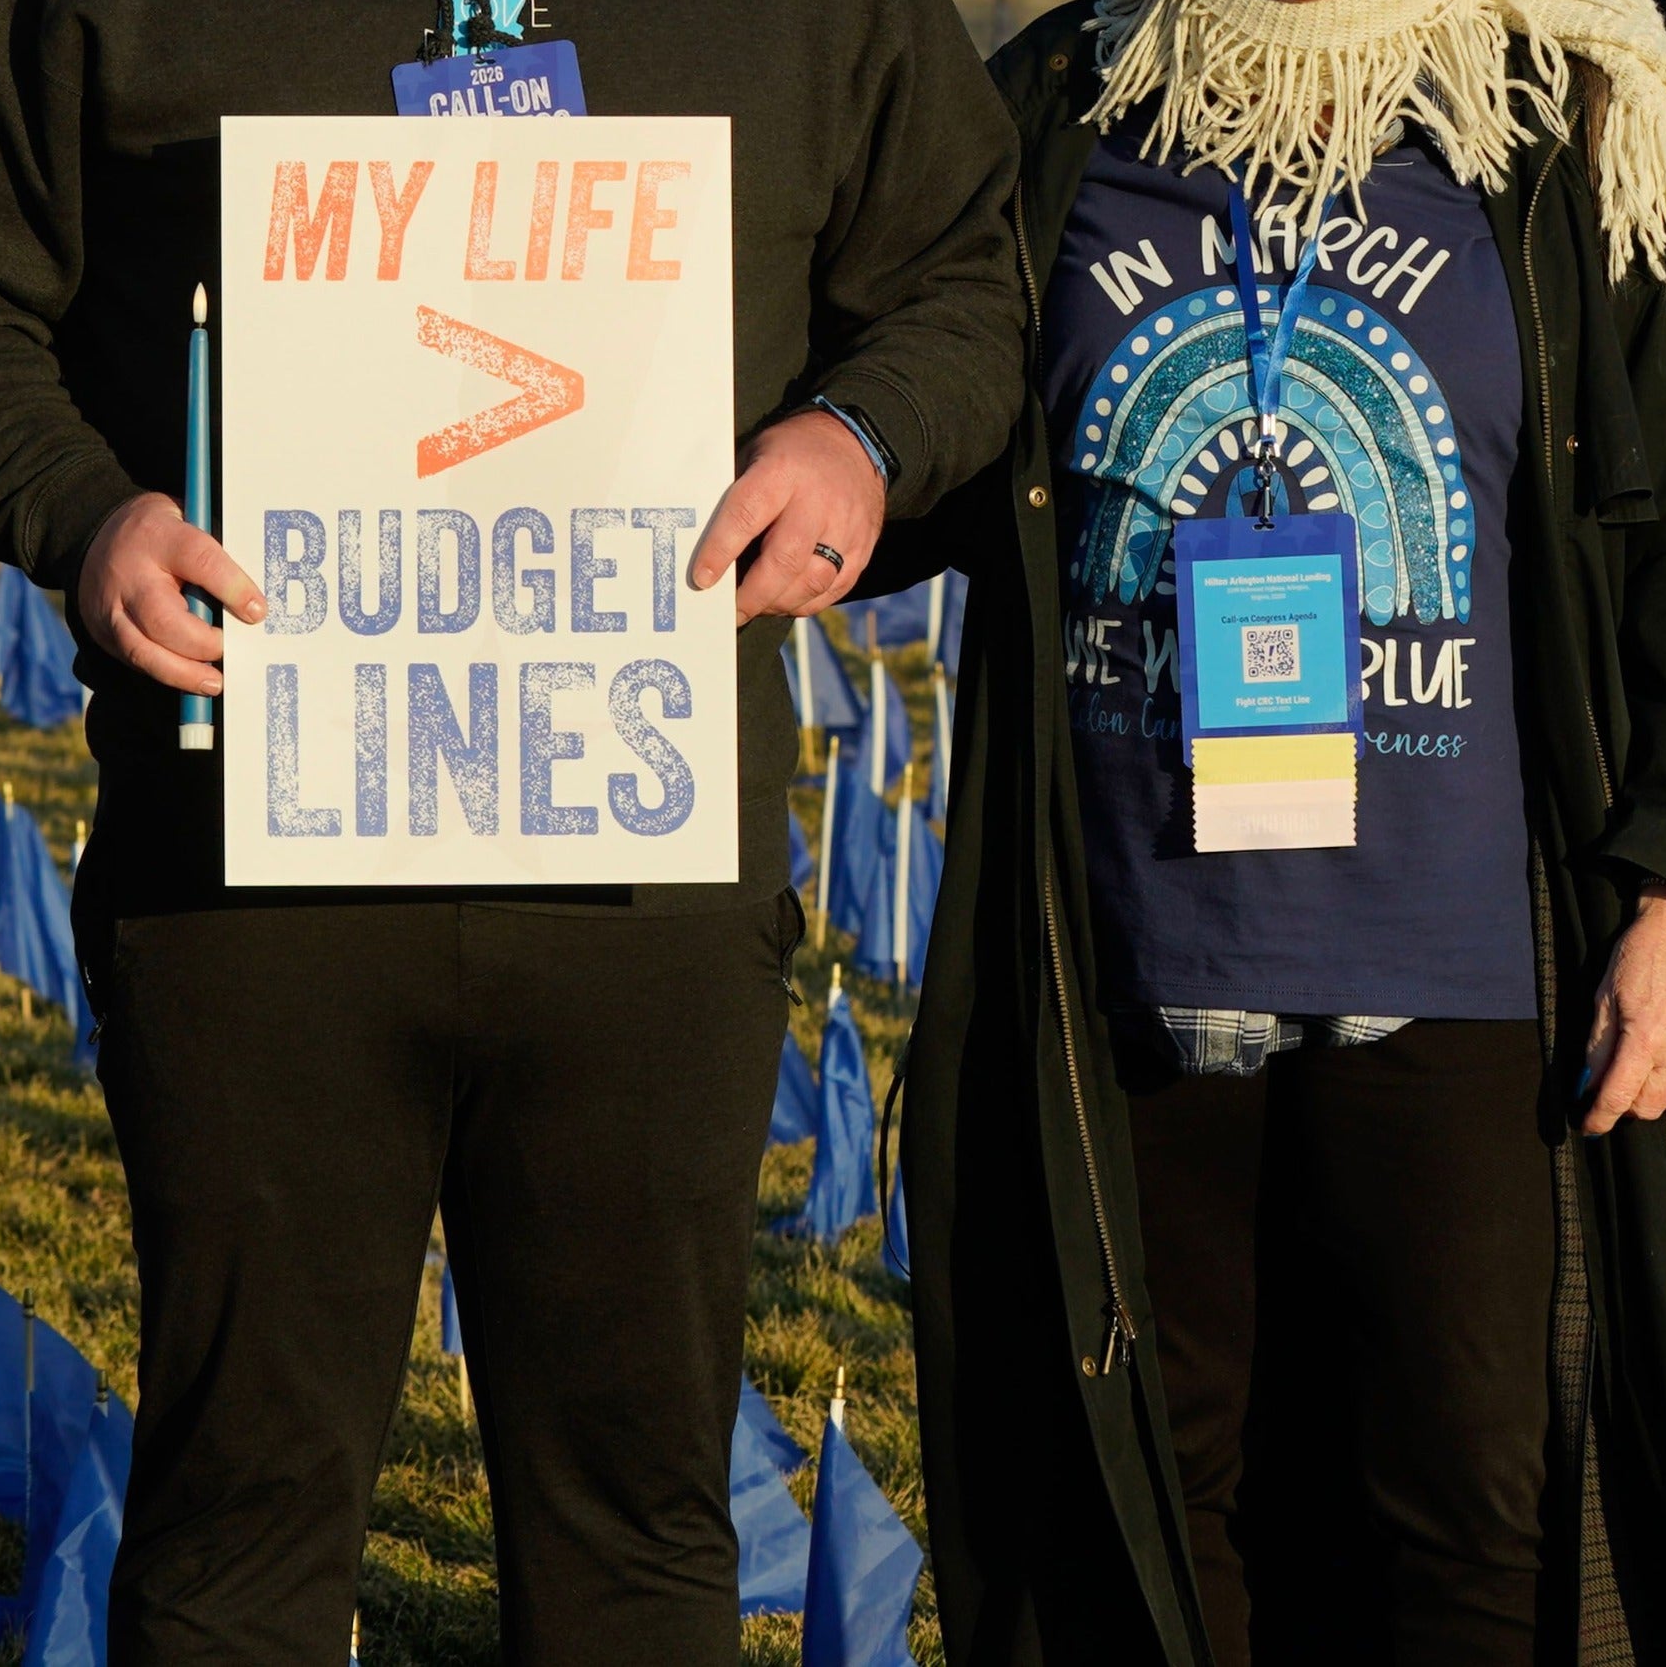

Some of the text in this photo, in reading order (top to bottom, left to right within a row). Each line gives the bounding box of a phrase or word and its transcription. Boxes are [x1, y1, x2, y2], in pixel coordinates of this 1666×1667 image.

[429, 76, 552, 116] CALL-ON
[470, 65, 504, 85] 2026
[263, 160, 692, 282] MY LIFE
[1090, 204, 1450, 316] IN MARCH
[263, 507, 698, 636] BUDGET
[1221, 612, 1317, 624] Call-on Congress Agenda
[266, 658, 696, 838] LINES
